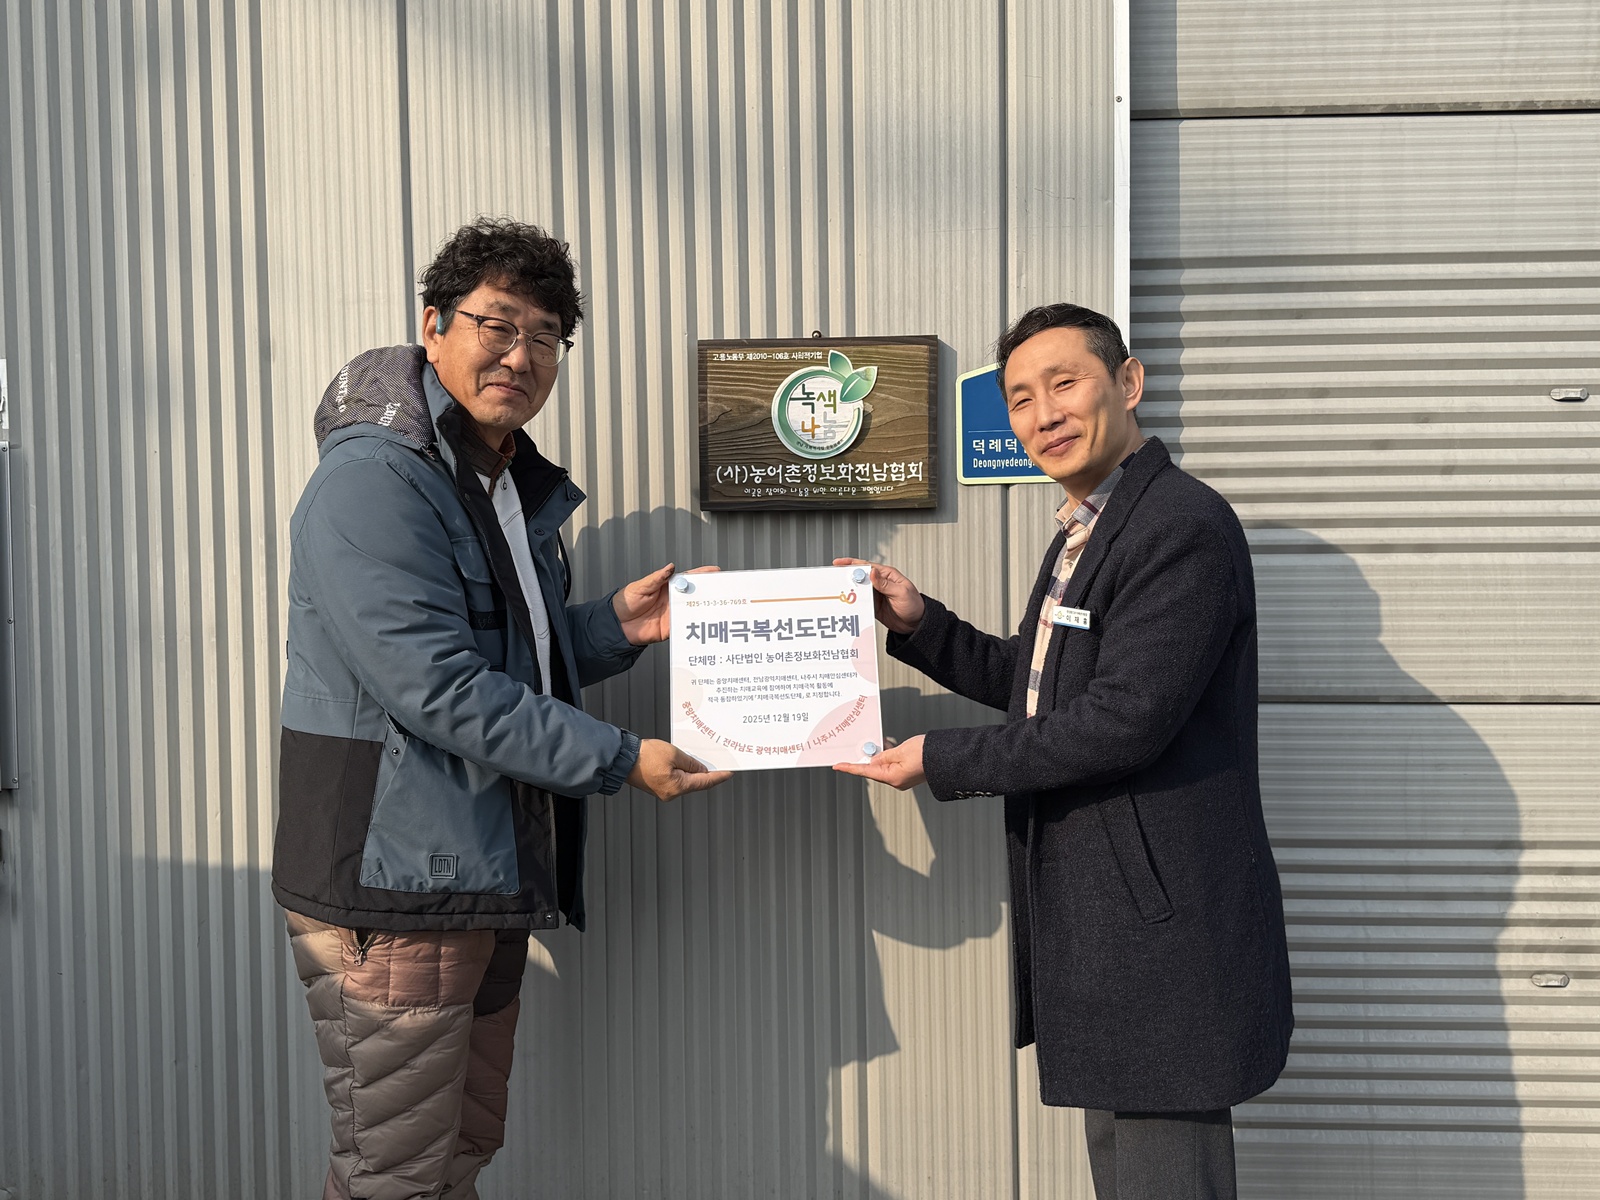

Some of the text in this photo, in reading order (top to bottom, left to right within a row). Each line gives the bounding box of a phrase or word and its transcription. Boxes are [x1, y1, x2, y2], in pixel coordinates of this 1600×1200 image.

[712, 351, 823, 362] 고용노동부 제2010-106호 사회적기업
[789, 383, 836, 414] 녹색
[801, 411, 849, 440] 나눔
[972, 438, 1027, 454] 덕례덕
[973, 458, 1034, 469] Deongnyedeong
[716, 461, 923, 484] (사)농어촌정보화전남협회
[744, 485, 894, 498] 이곳은 참여와 나눔을 위한 아름다운 기업입니다
[686, 614, 860, 644] 치매극복선도단체
[688, 655, 716, 666] 단체명
[726, 652, 763, 665] 사단법인
[766, 648, 859, 663] 농어촌정보화전남협회
[698, 678, 714, 686] 단체는
[716, 676, 752, 684] 중앙치매센터,
[753, 674, 800, 683] 전남광역치매센터,
[819, 672, 858, 680] 치매안심센터가
[716, 686, 738, 694] 추진하는
[740, 684, 768, 692] 치매교육에
[769, 684, 792, 692] 참여하여
[793, 682, 815, 690] 치매극복
[812, 690, 842, 698] 지정합니다.
[682, 694, 868, 756] 중앙치매센터 전라남도 광역치매센터 나주시 치매안심센터
[742, 712, 809, 724] 2025년 12월 19일
[434, 858, 452, 874] LDTN
